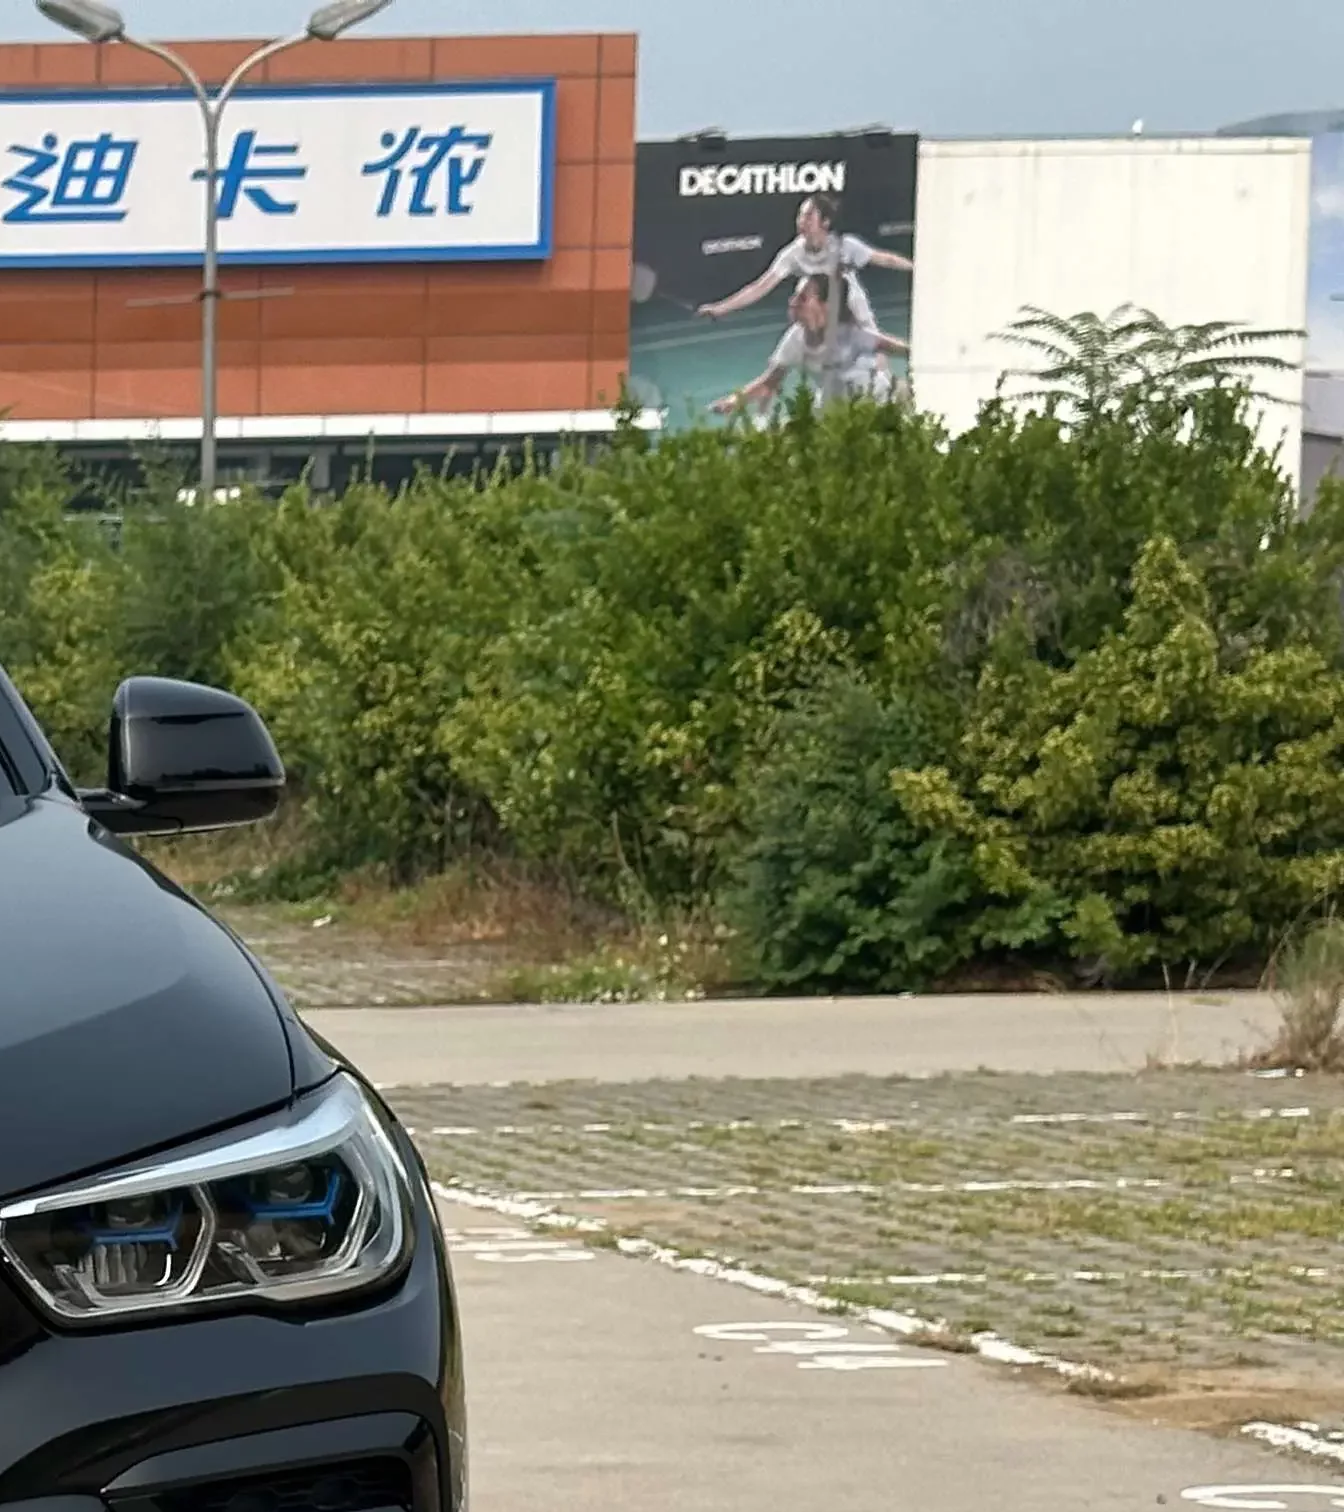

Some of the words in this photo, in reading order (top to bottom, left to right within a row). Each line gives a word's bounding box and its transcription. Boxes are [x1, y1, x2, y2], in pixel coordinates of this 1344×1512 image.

[1, 125, 492, 223] 迪卡侬
[679, 161, 847, 196] DECATHLON
